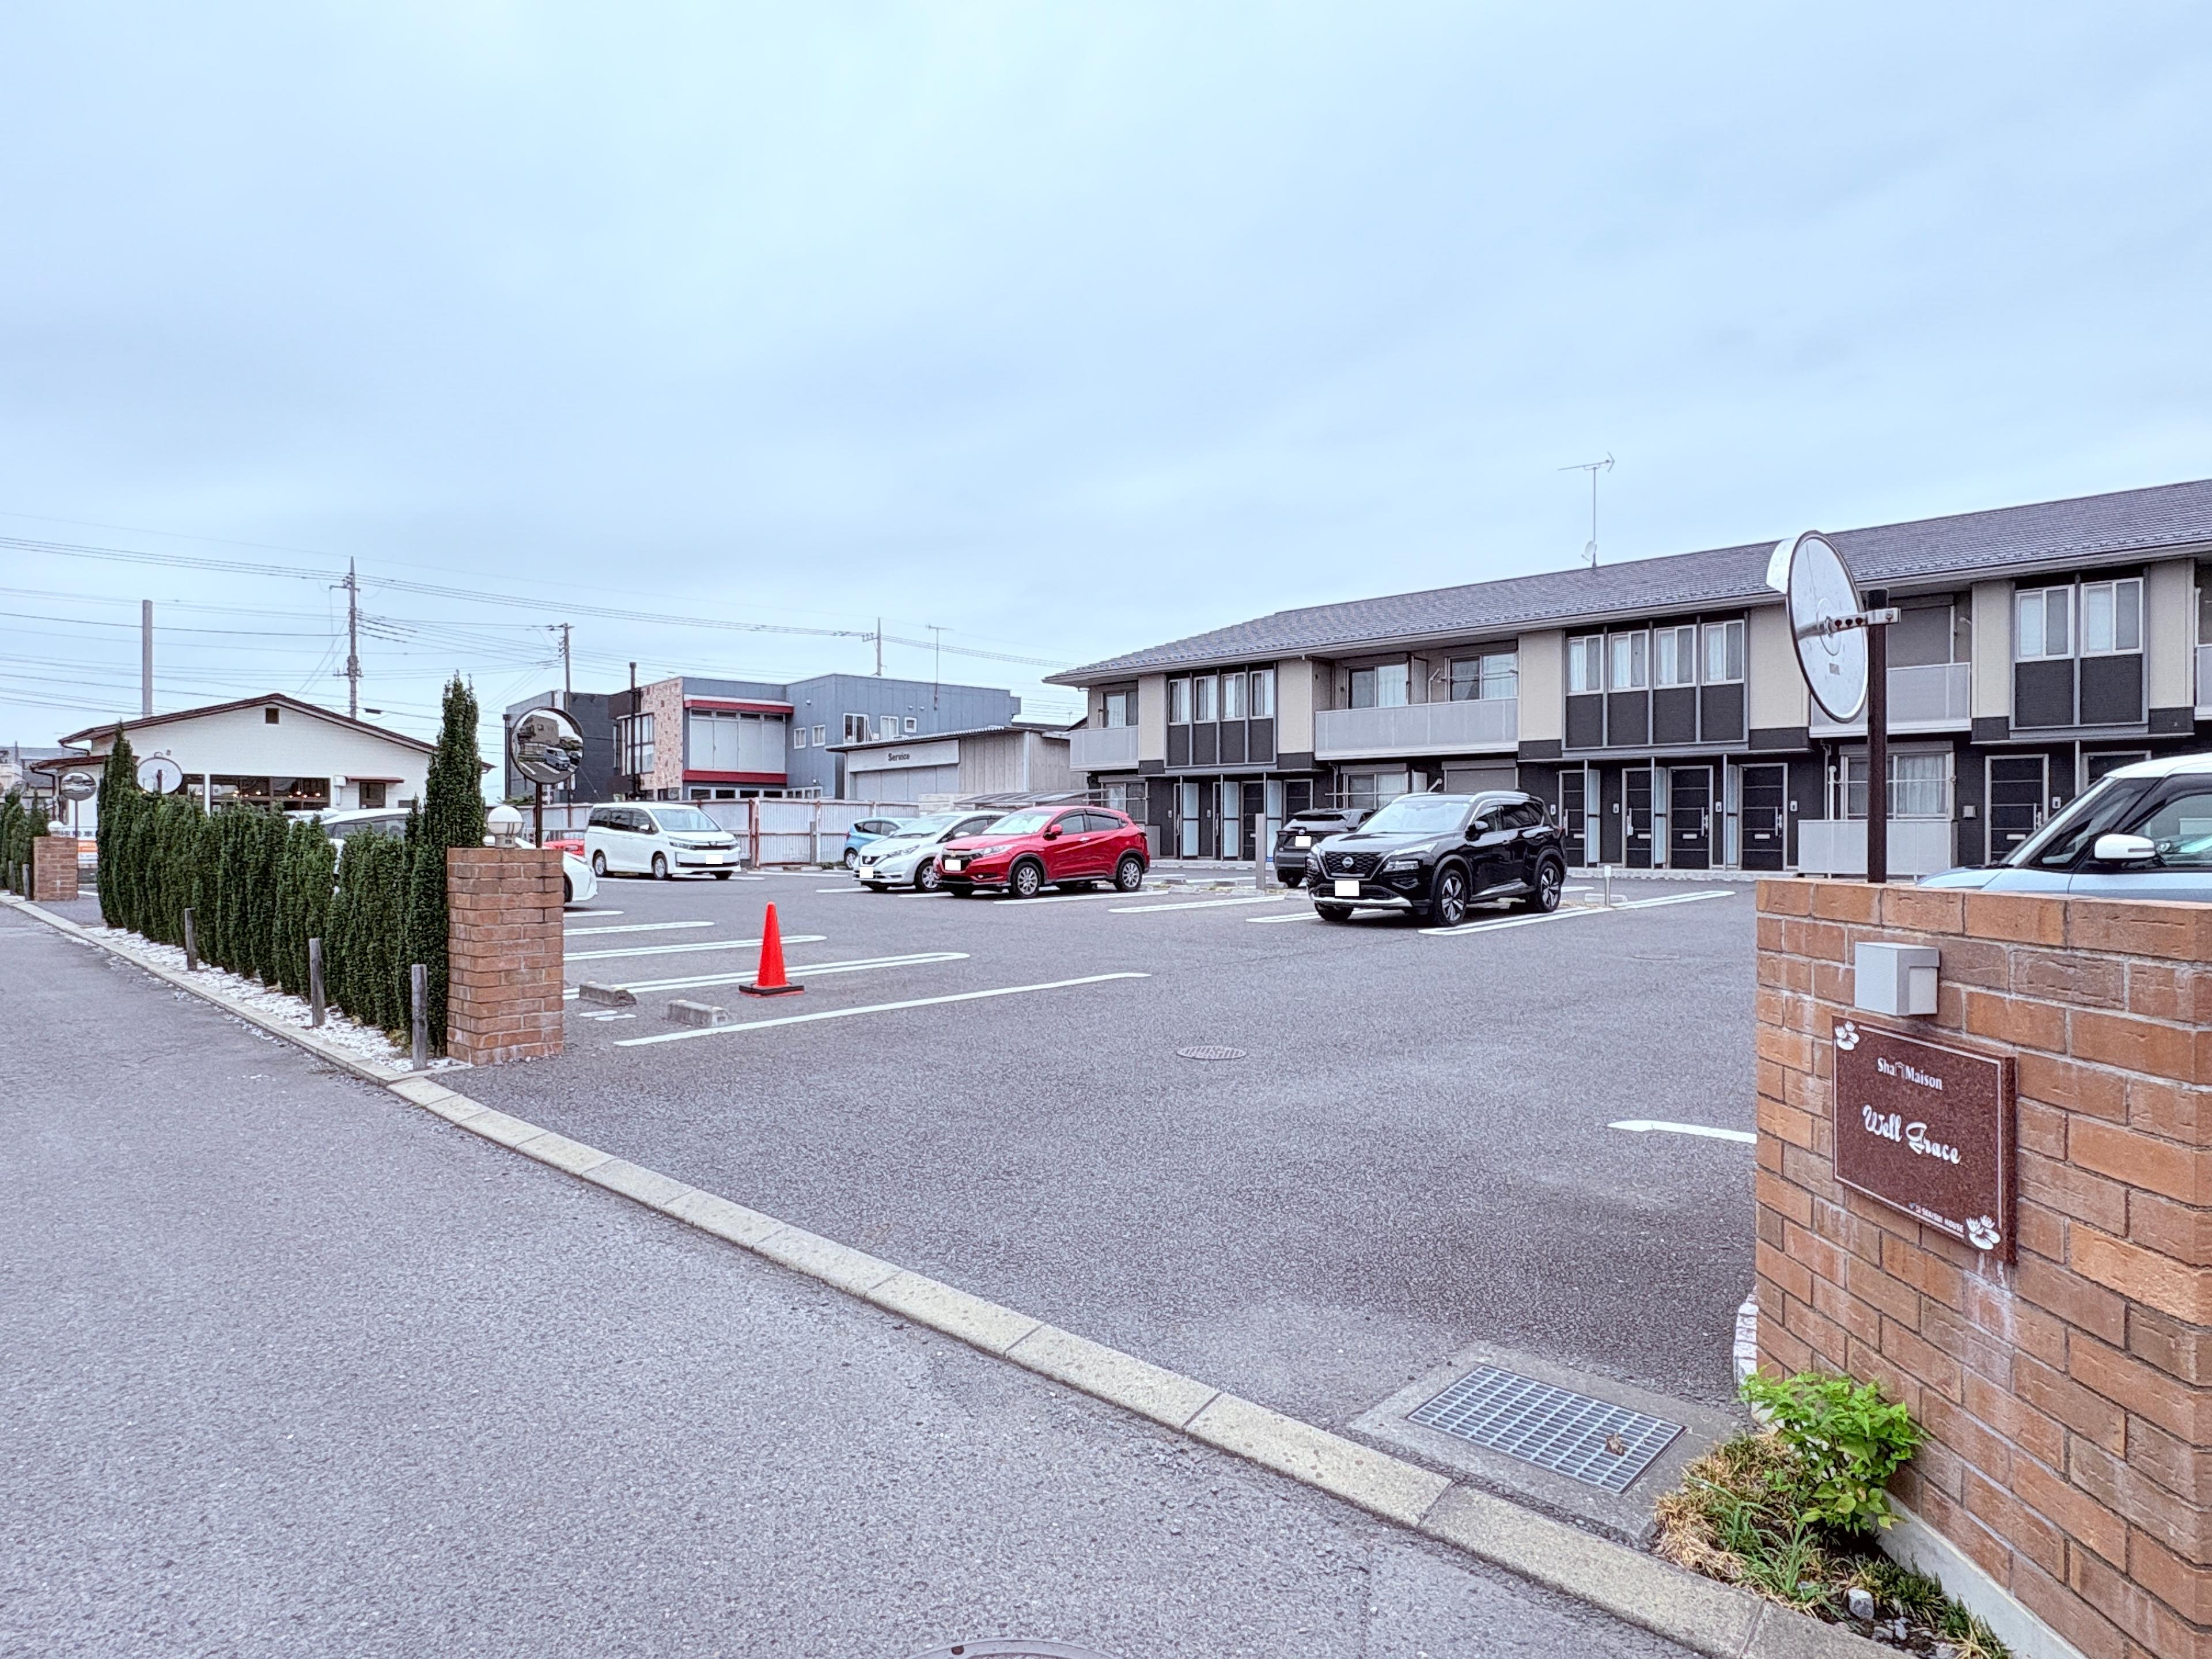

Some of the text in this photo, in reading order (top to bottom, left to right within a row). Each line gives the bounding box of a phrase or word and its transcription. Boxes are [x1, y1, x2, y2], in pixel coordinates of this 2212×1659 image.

[888, 752, 910, 762] Service
[1905, 1065, 1942, 1090] Maison
[1862, 1104, 1962, 1164] Well Grace
